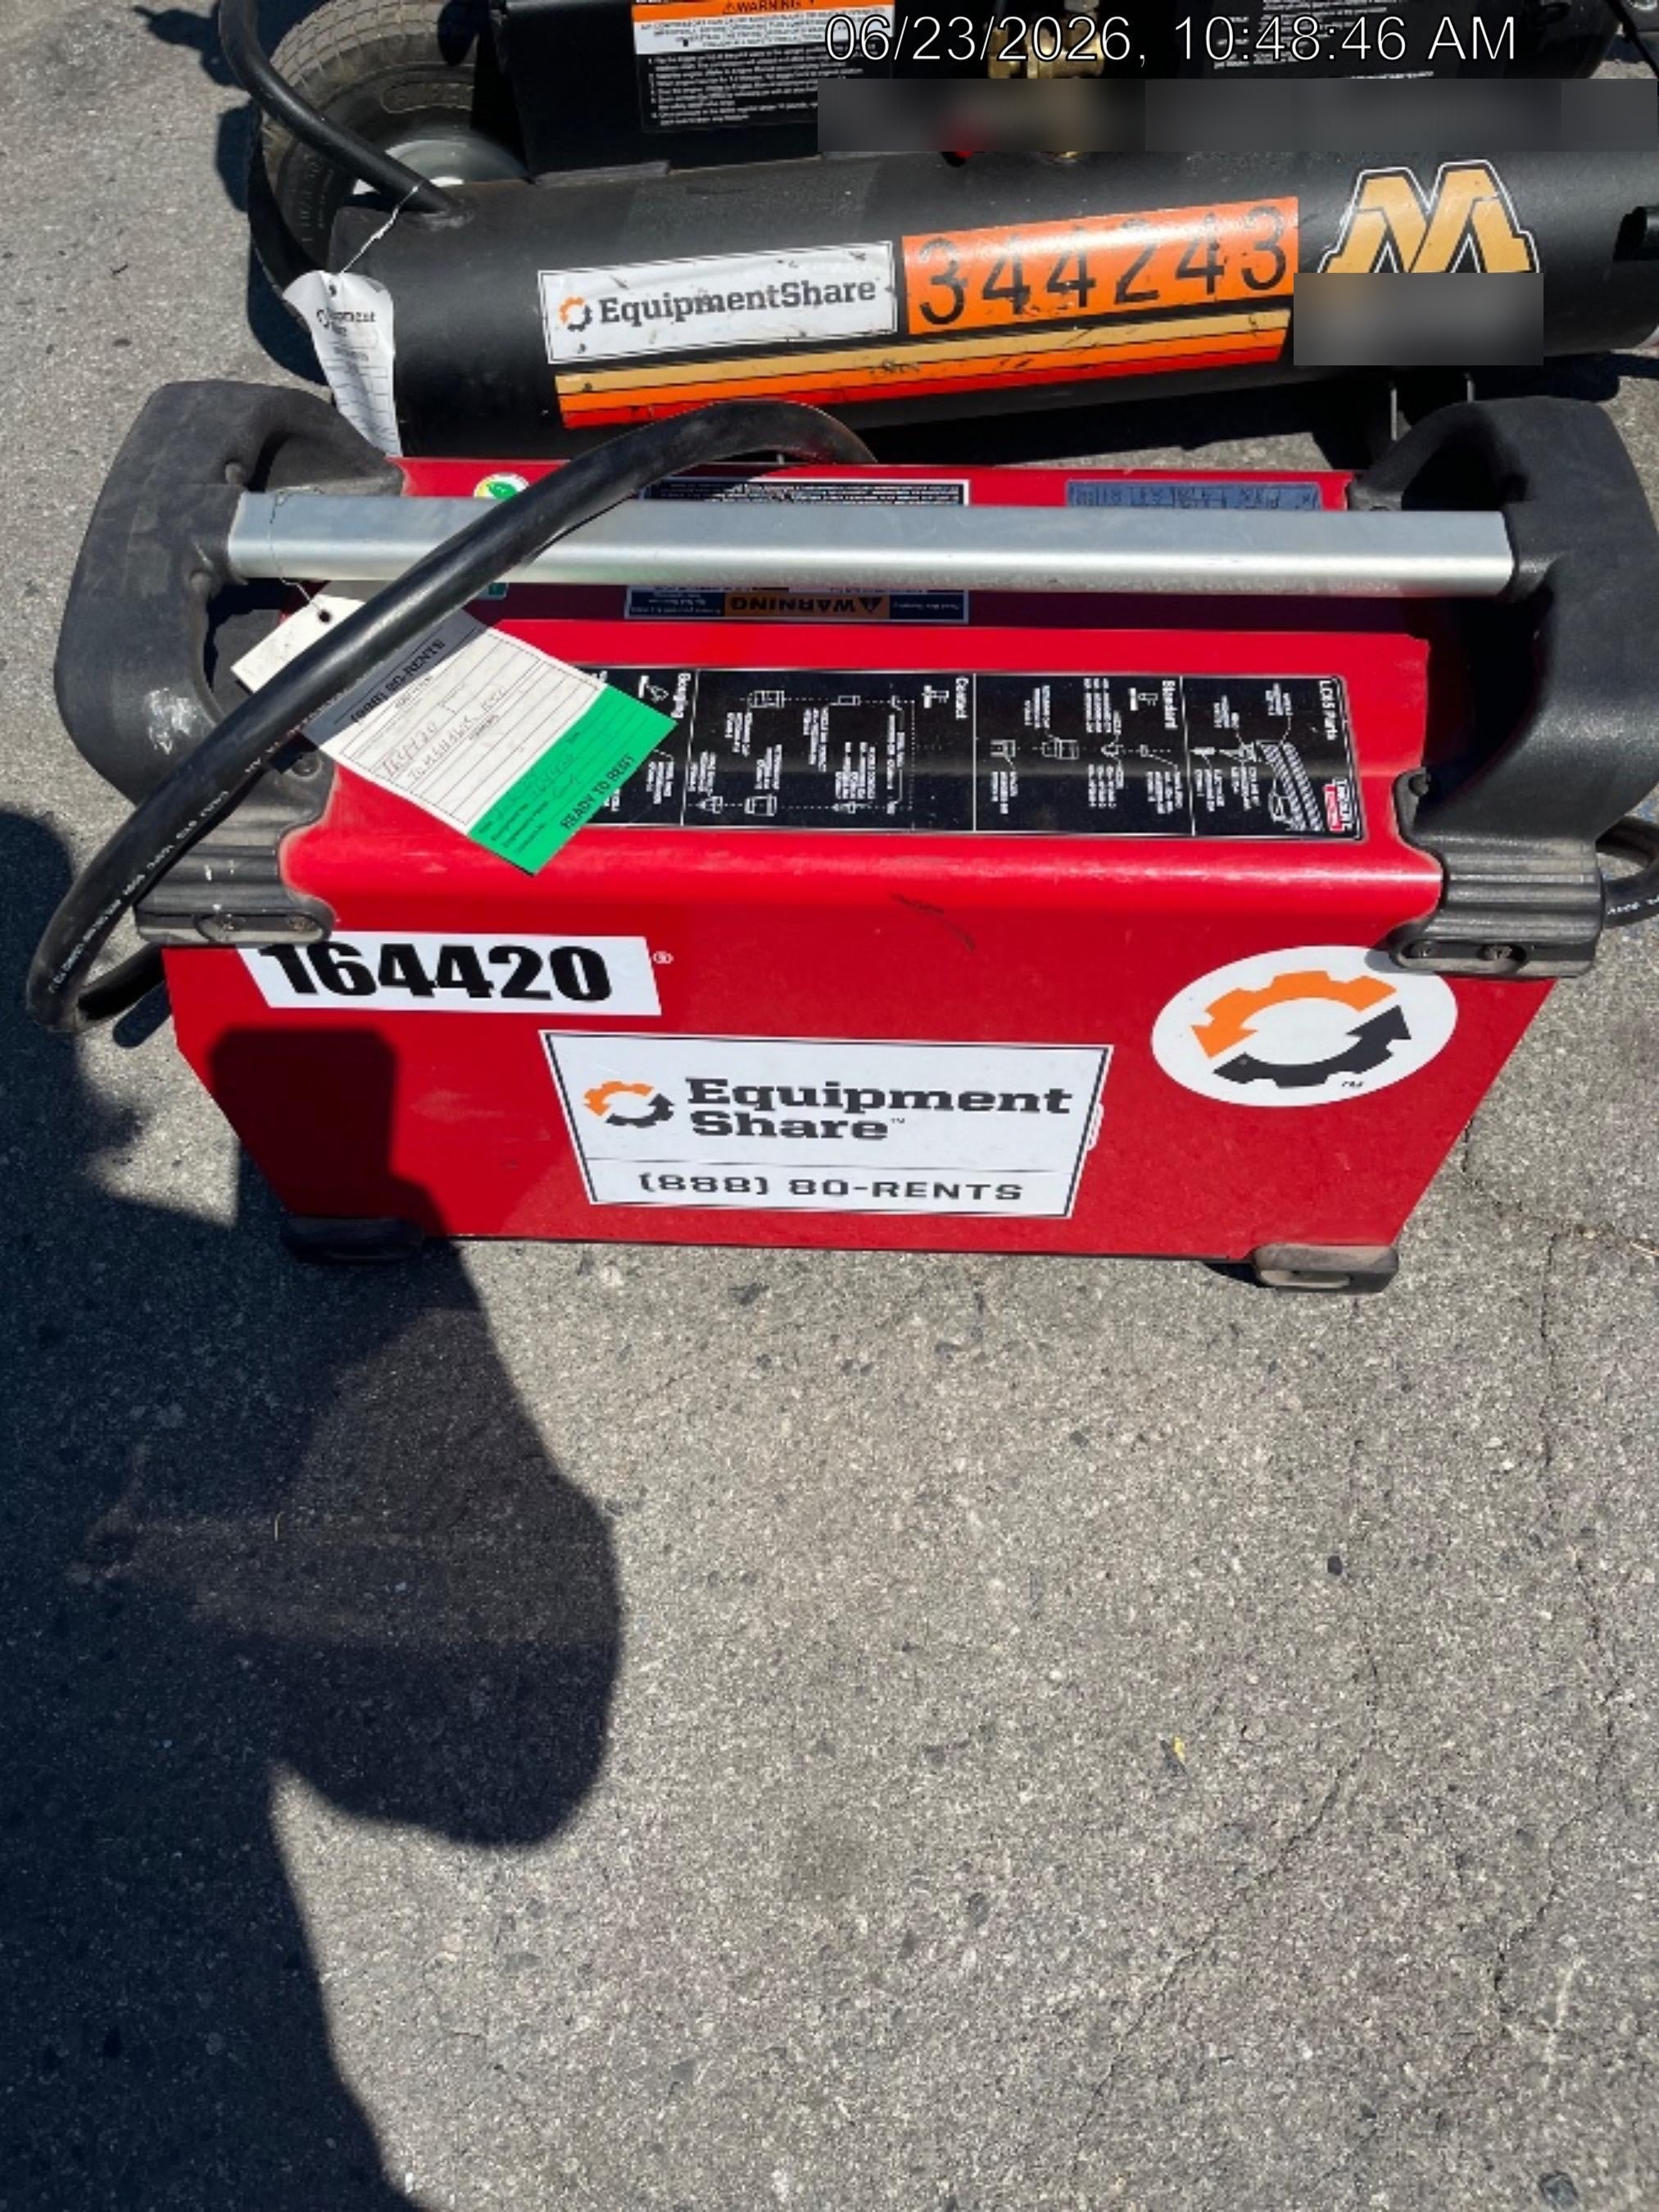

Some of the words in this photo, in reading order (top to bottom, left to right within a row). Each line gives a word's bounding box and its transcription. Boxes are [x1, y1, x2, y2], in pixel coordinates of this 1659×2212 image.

[917, 204, 1290, 324] 344243
[601, 279, 876, 326] EquipmentShare
[731, 596, 856, 613] WARNING
[560, 791, 596, 832] READY
[595, 775, 613, 796] TO
[259, 941, 612, 1002] 164420
[685, 1077, 1072, 1115] Equipment
[690, 1111, 889, 1140] Share
[639, 1174, 769, 1195] (888)
[789, 1178, 1023, 1201] 80-RENTS
